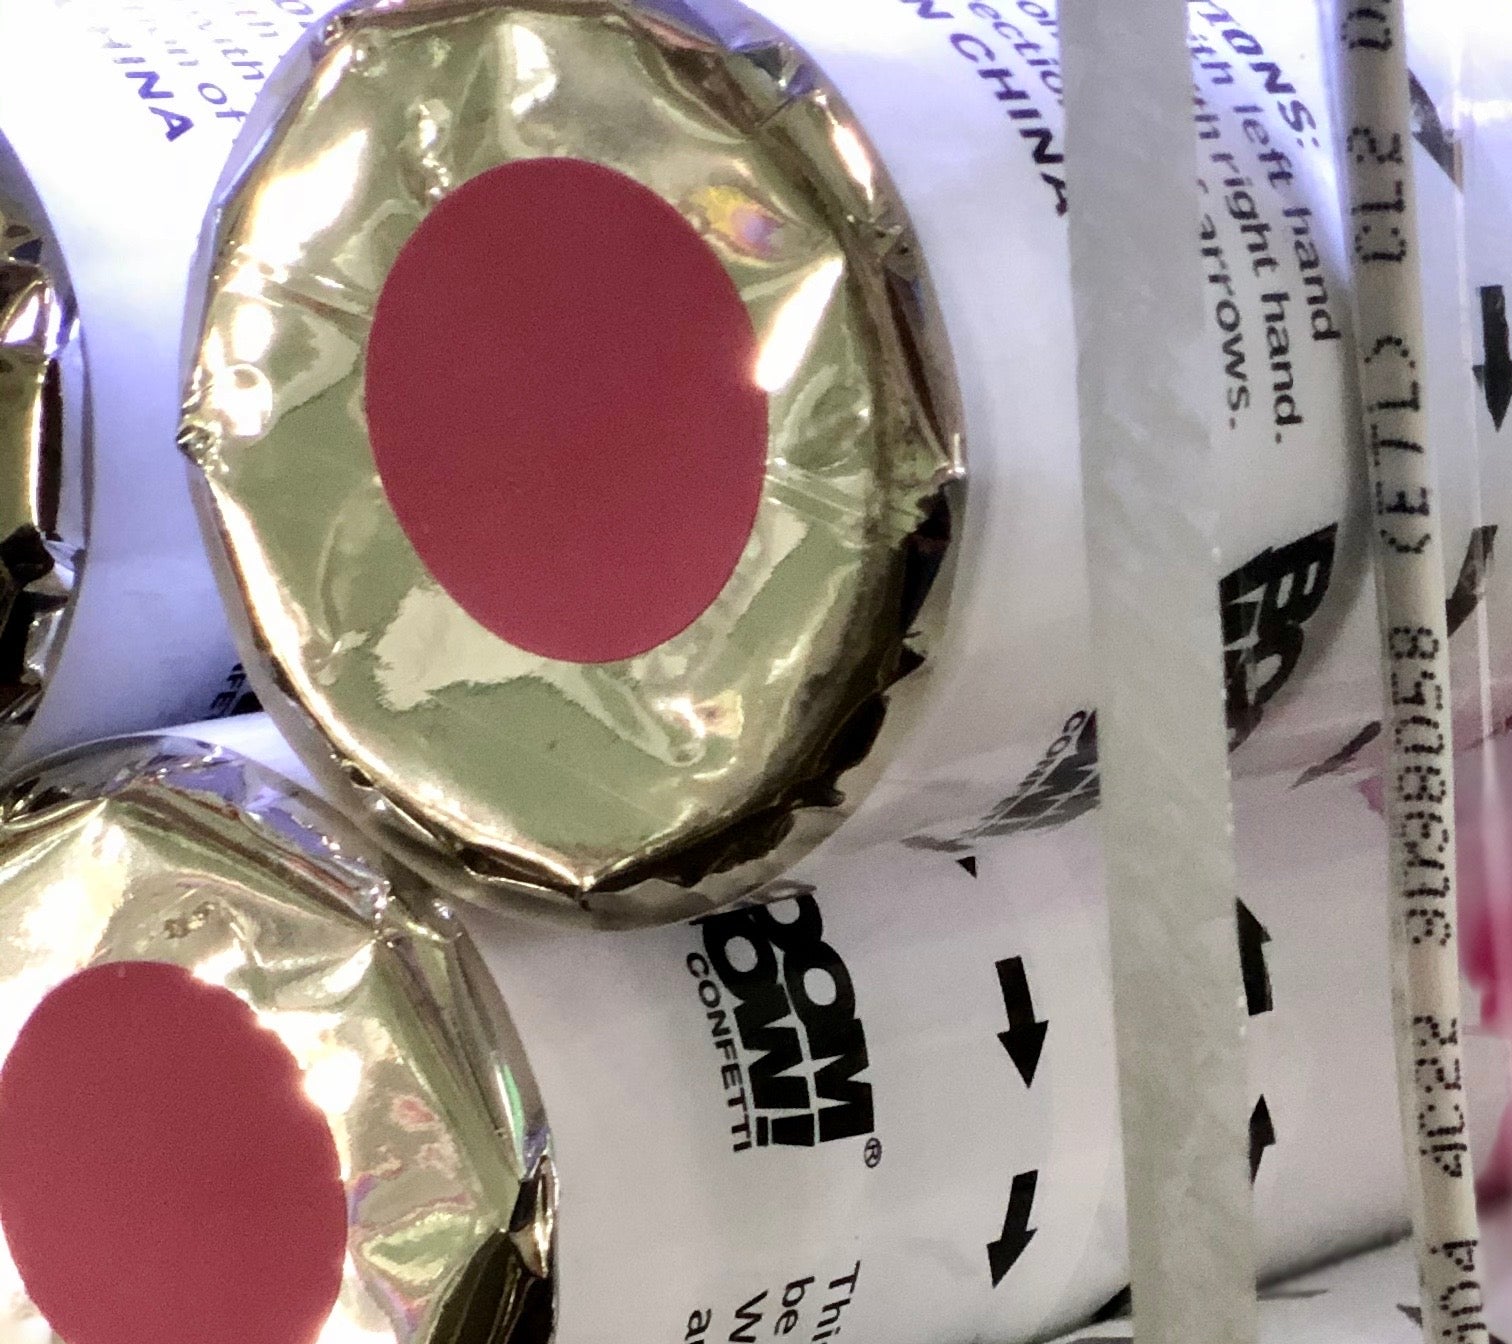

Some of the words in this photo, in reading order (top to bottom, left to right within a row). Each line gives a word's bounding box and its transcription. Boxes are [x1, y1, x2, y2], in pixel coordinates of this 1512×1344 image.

[1210, 152, 1280, 279] right
[1260, 291, 1304, 445] hand.
[1232, 104, 1294, 189] left
[1282, 206, 1342, 341] hand
[1347, 126, 1407, 264] CL2
[1200, 211, 1251, 430] arrows.
[686, 951, 753, 1153] CONFETTI
[774, 1275, 816, 1336] be
